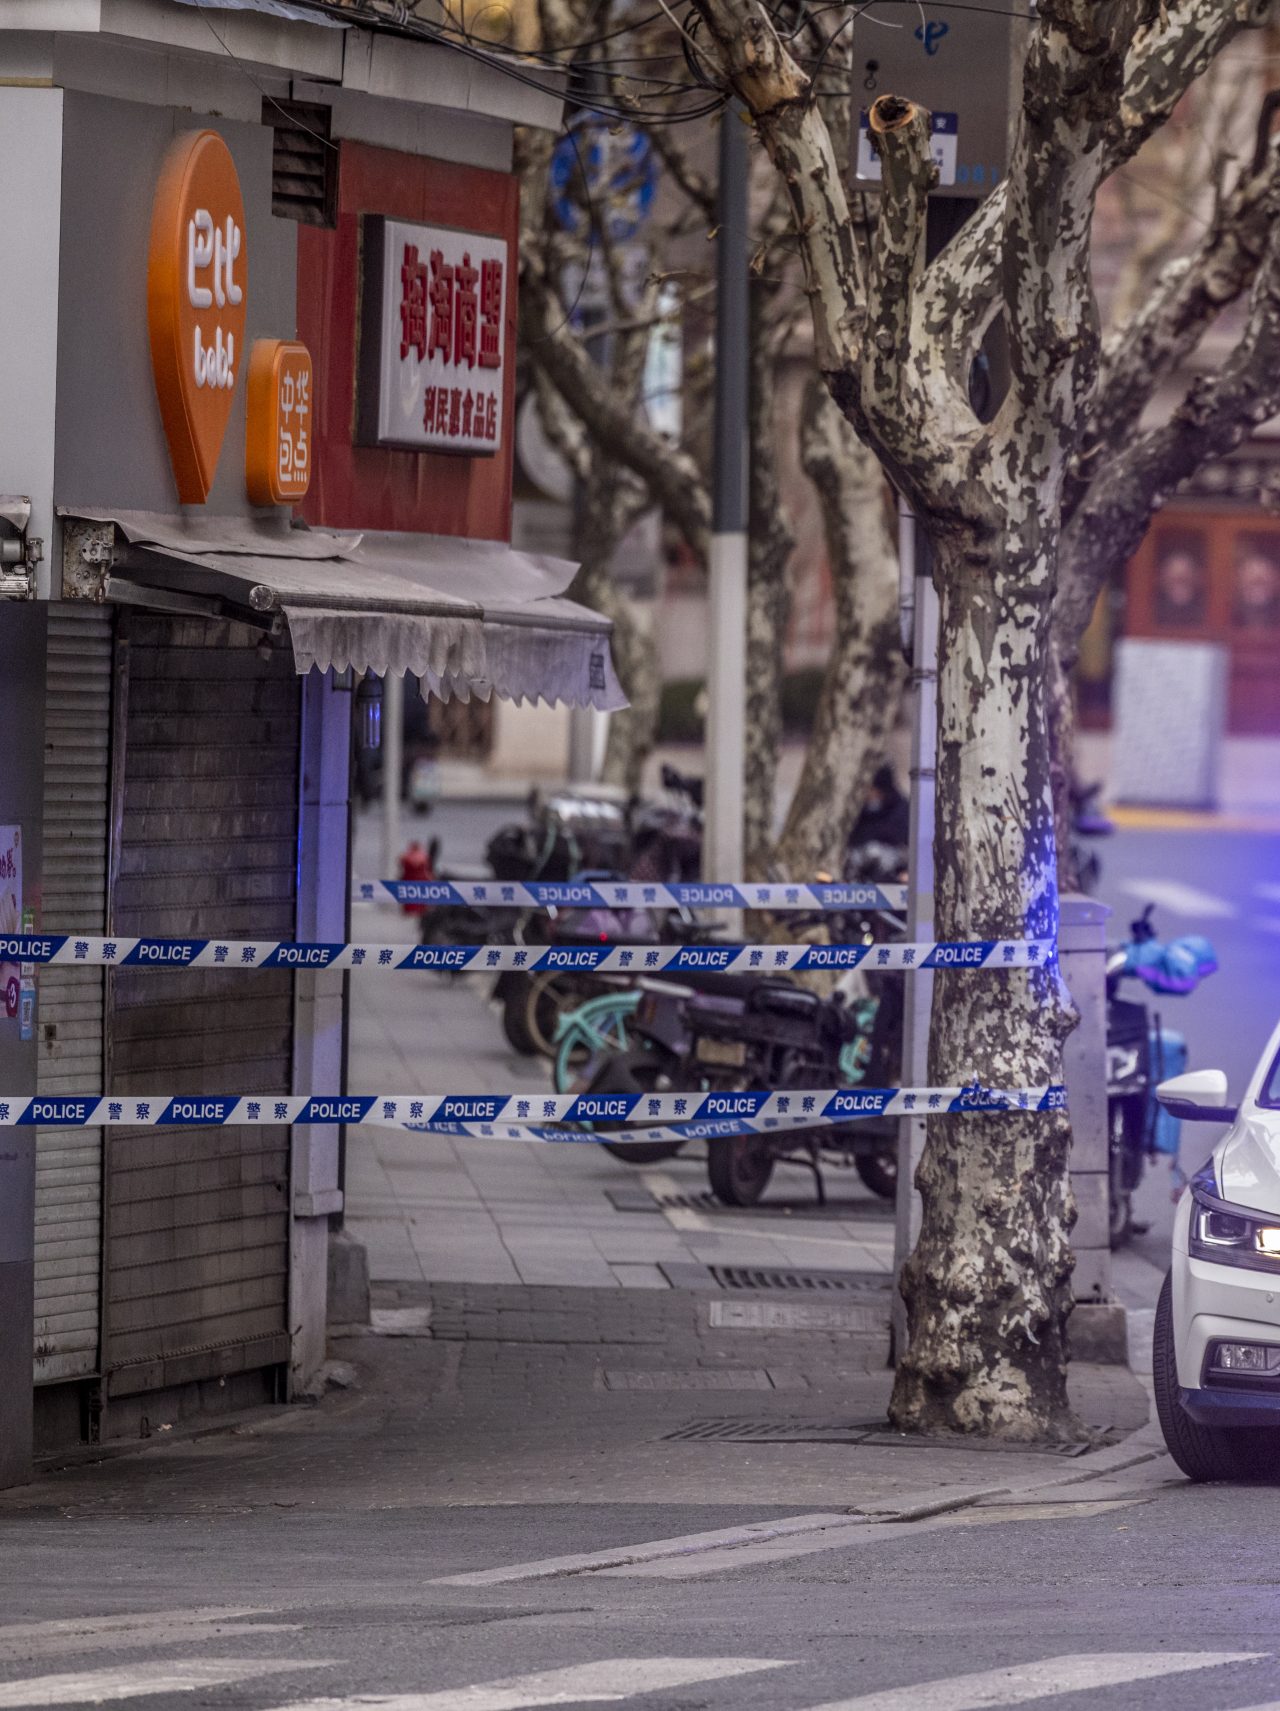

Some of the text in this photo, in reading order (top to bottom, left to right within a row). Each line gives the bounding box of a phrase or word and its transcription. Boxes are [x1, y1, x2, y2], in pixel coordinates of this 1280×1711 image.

[0, 940, 51, 957] POLICE
[138, 945, 191, 961] POLICE
[277, 948, 330, 963] POLICE
[413, 950, 465, 965] POLICE
[547, 952, 598, 966] POLICE
[679, 952, 729, 966] POLICE
[808, 951, 857, 965] POLICE
[935, 948, 982, 963] POLICE
[32, 1104, 85, 1119] POLICE
[172, 1103, 224, 1119] POLICE
[310, 1103, 361, 1119] POLICE
[445, 1102, 494, 1117] POLICE
[577, 1101, 626, 1115] POLICE
[707, 1098, 756, 1113] POLICE
[835, 1095, 884, 1111] POLICE
